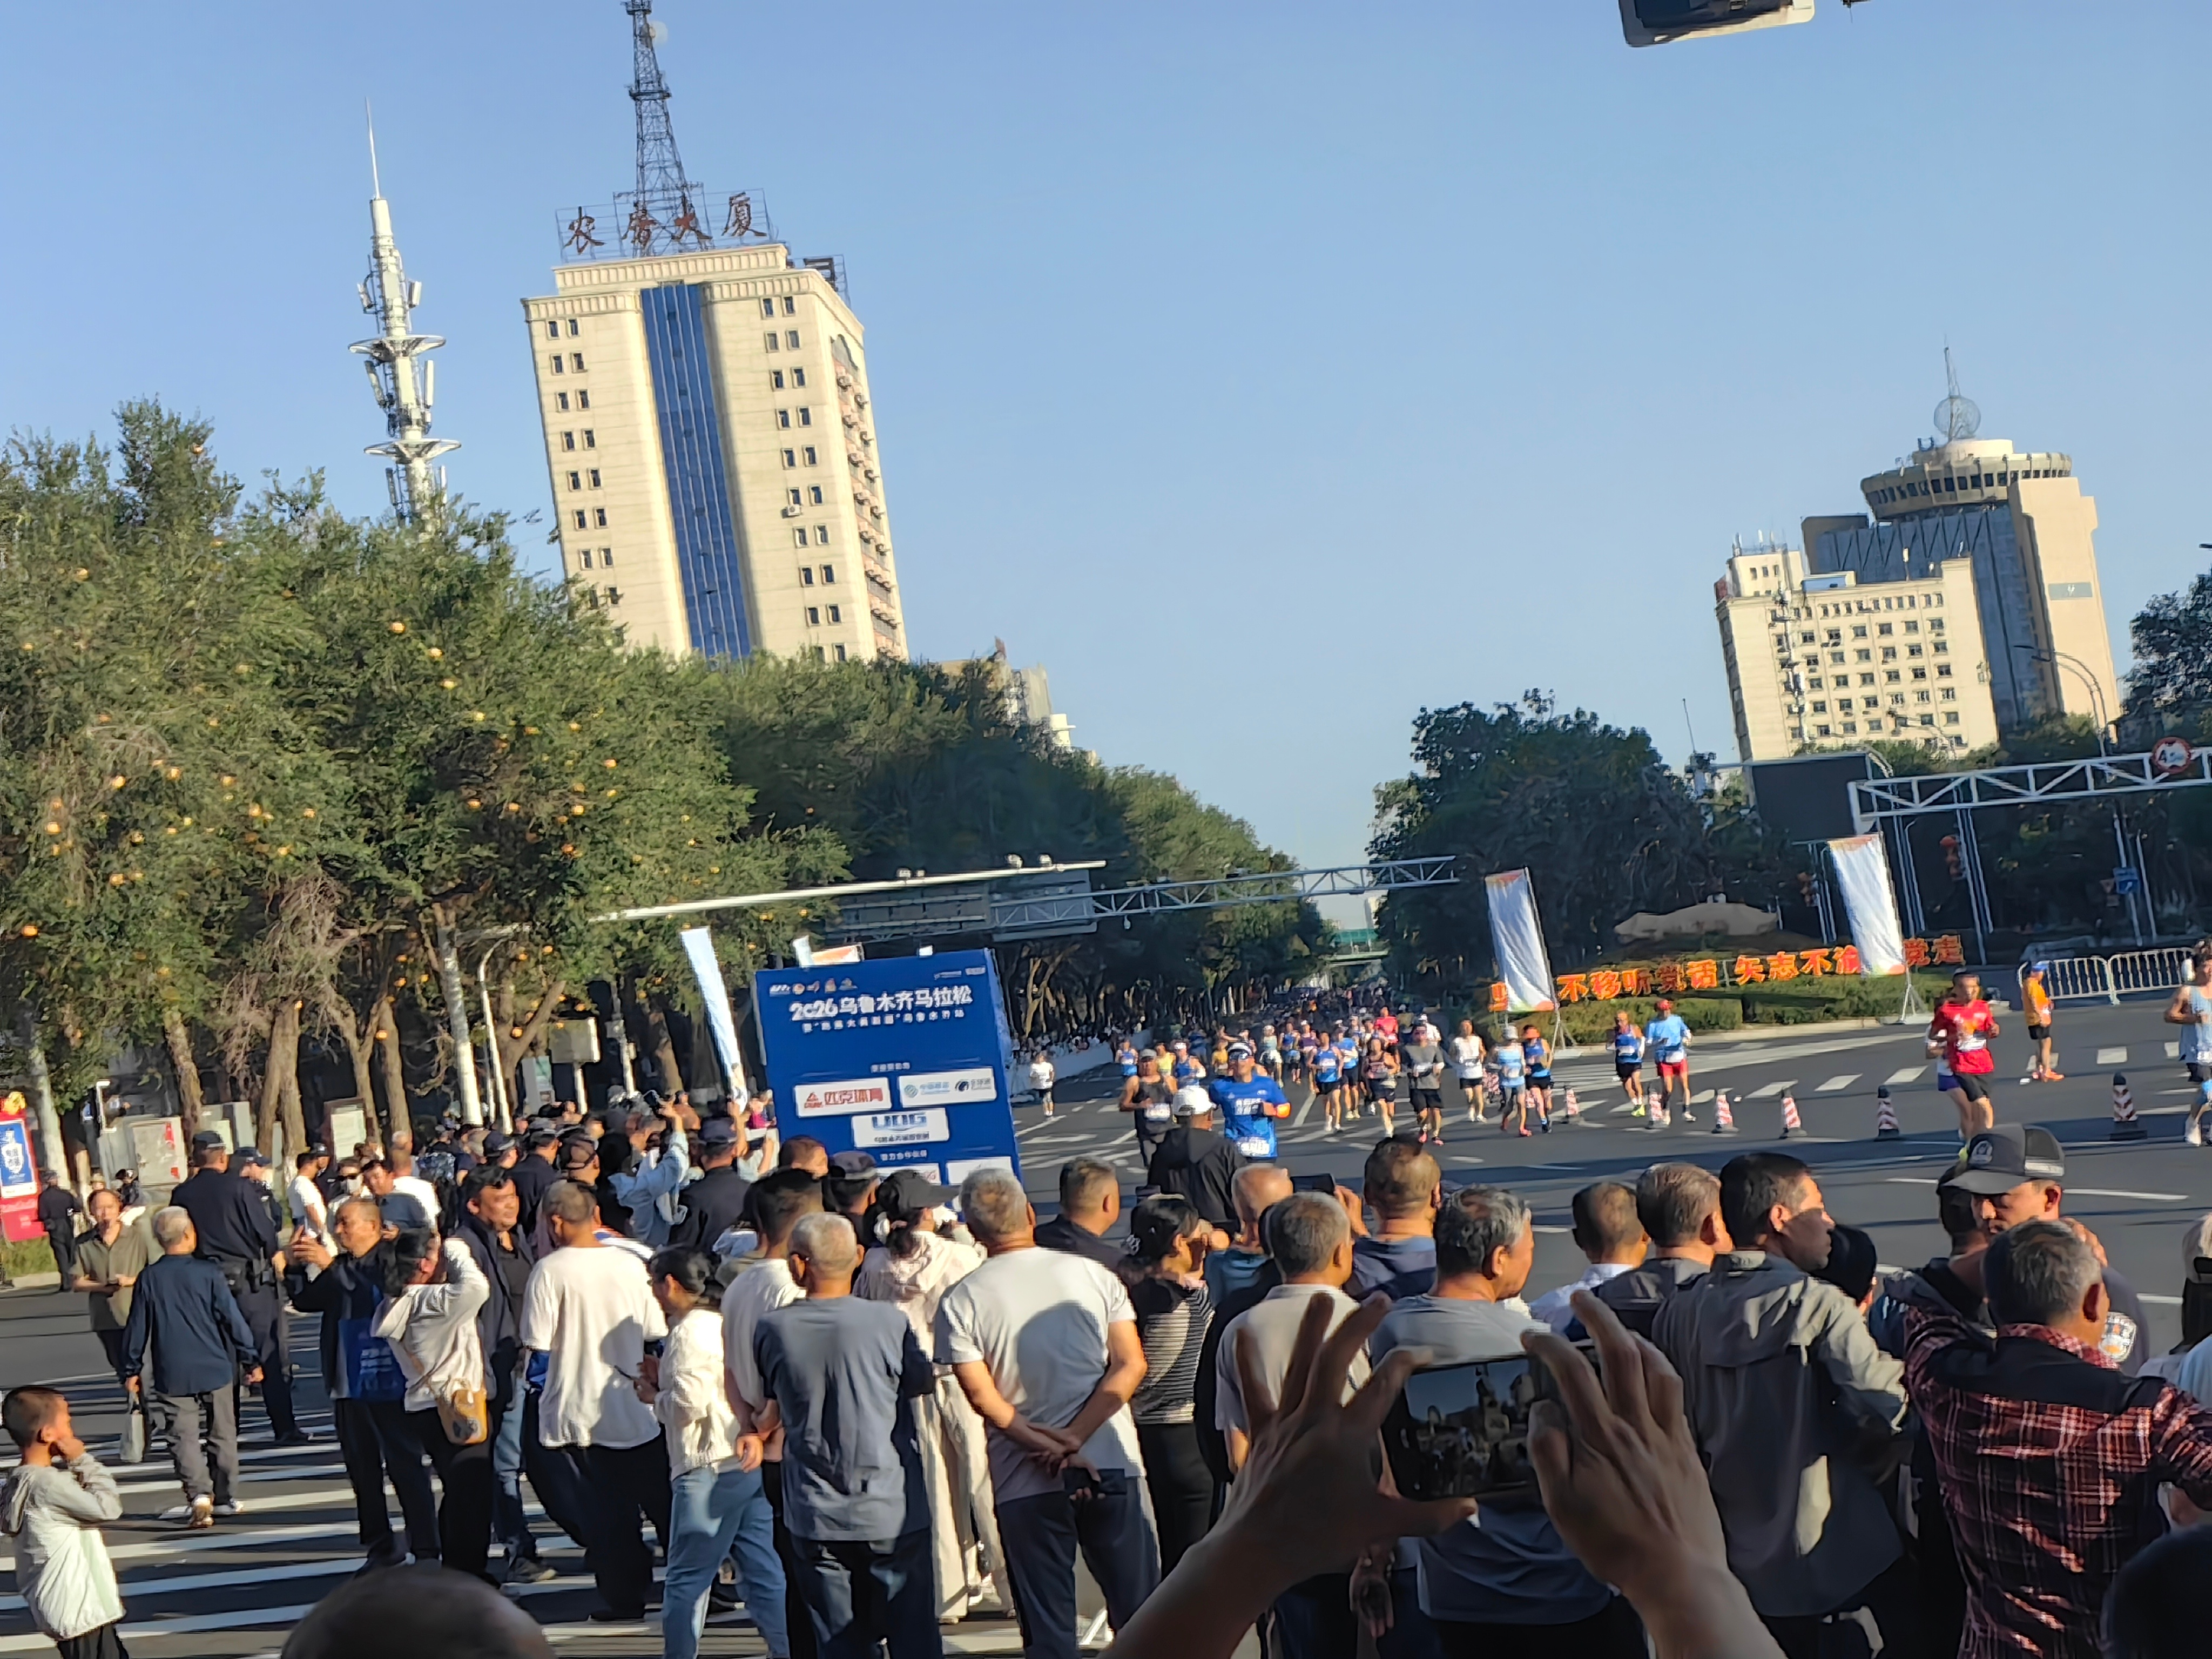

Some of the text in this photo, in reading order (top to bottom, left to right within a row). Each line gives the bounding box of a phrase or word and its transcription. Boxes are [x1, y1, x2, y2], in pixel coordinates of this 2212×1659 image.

[1734, 934, 1963, 986] 矢志不渝党走
